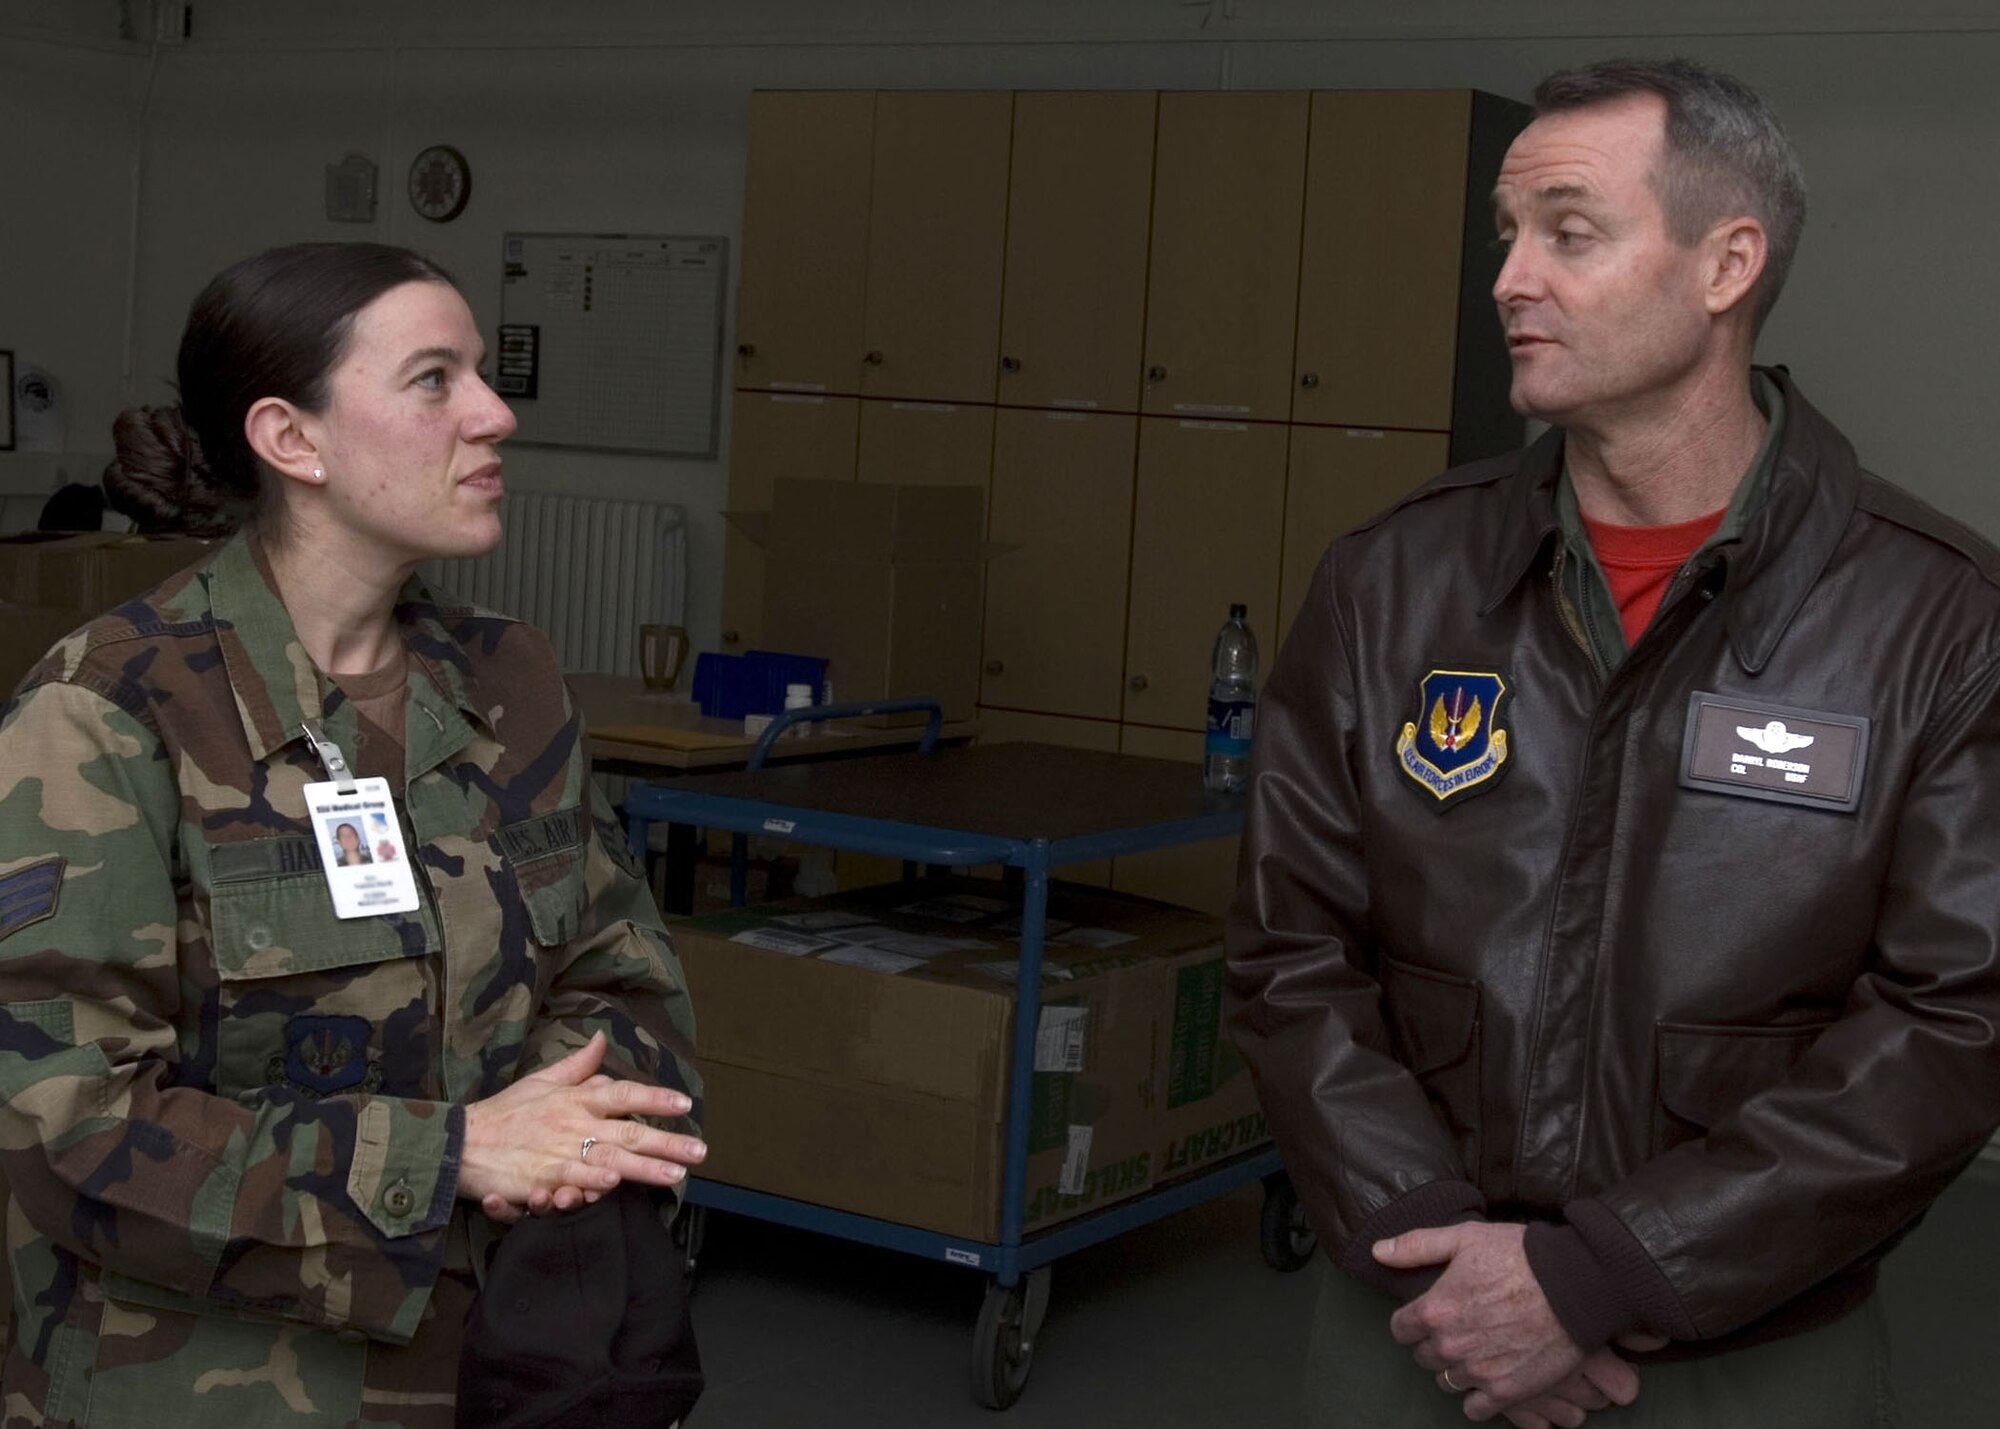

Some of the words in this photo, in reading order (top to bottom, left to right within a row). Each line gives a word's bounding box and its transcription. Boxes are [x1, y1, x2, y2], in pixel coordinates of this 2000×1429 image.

[1424, 768, 1454, 792] FORCES
[1455, 773, 1466, 785] IN
[1466, 753, 1496, 781] EUROPE
[1731, 764, 1747, 775] COL
[543, 815, 574, 849] AIR
[1163, 1112, 1267, 1173] KILCRAFT
